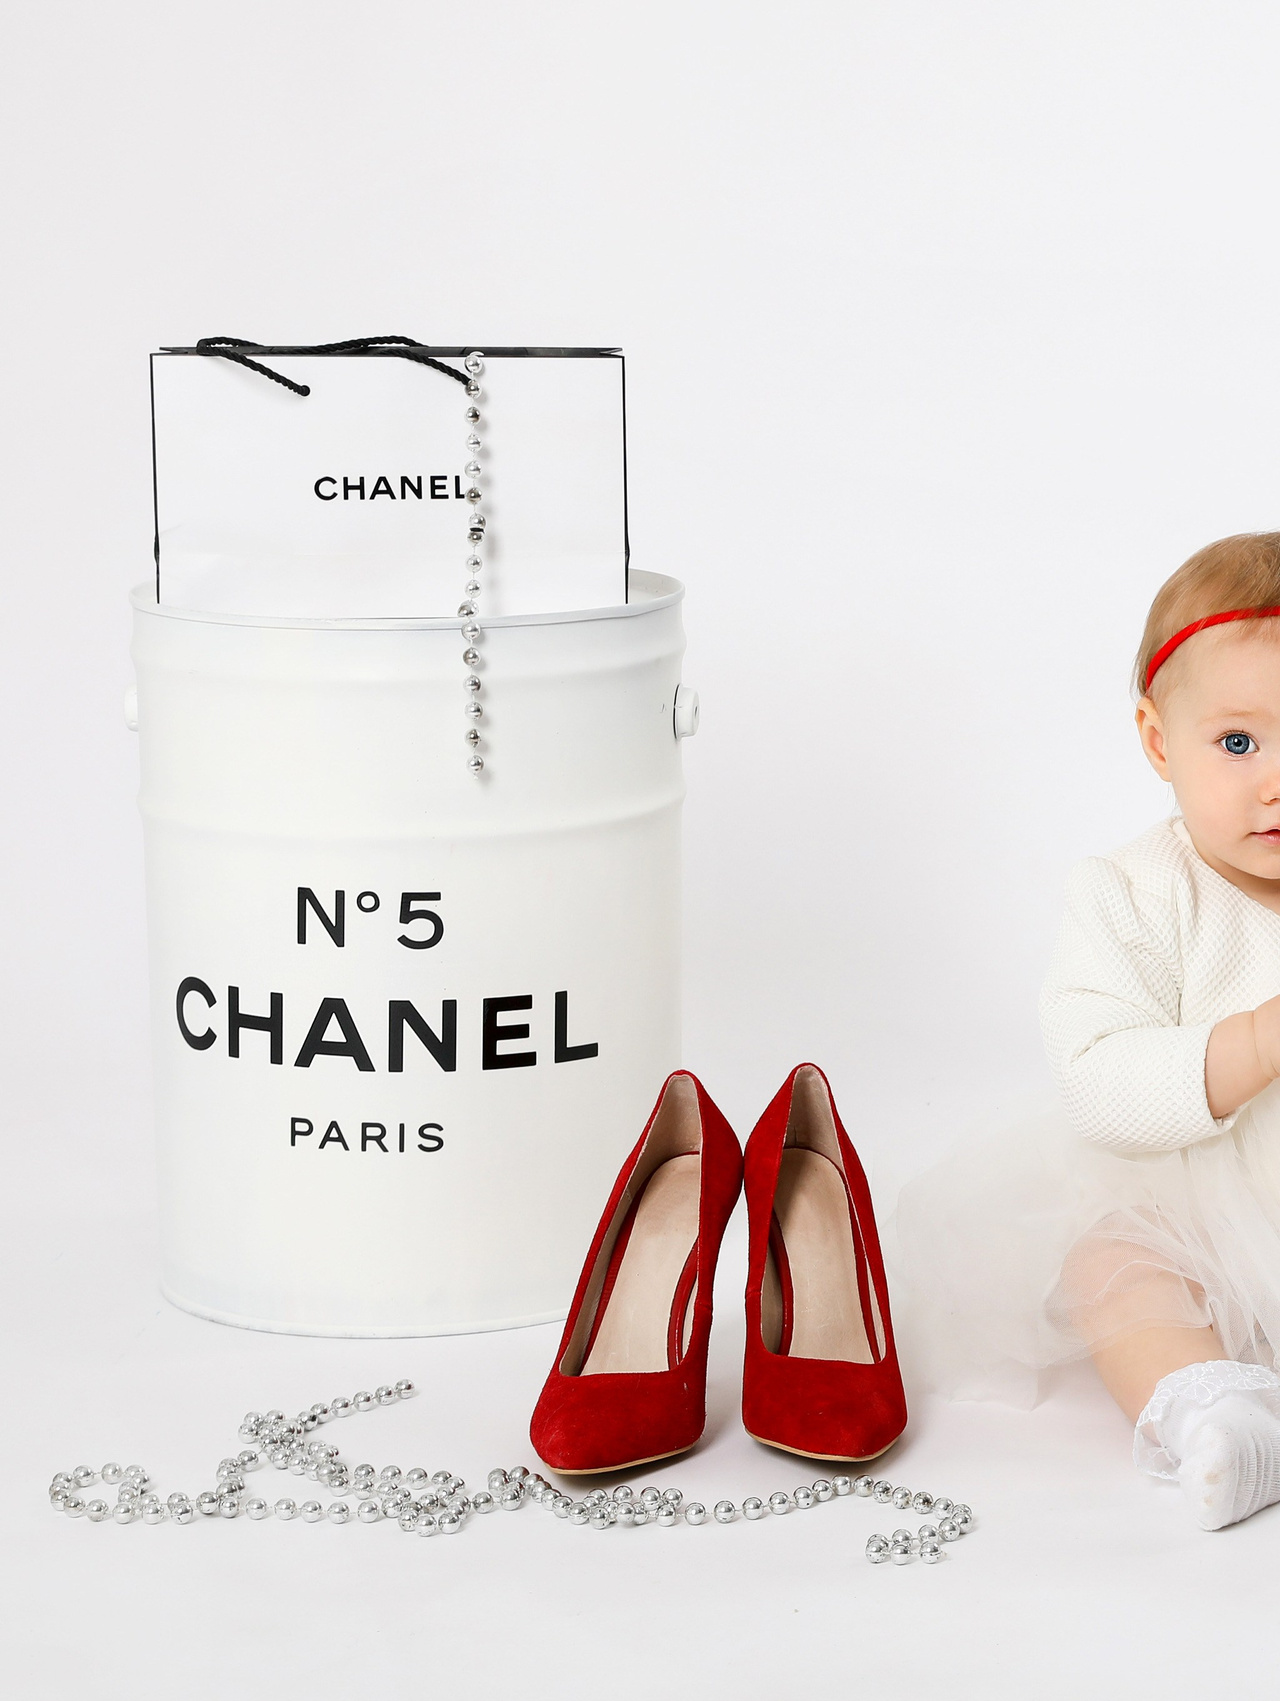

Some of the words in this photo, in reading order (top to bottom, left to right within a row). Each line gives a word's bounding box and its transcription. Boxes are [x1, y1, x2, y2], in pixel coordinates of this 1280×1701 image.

[313, 475, 467, 501] CHANEL
[174, 976, 600, 1073] CHANEL
[289, 1116, 445, 1153] PARIS
